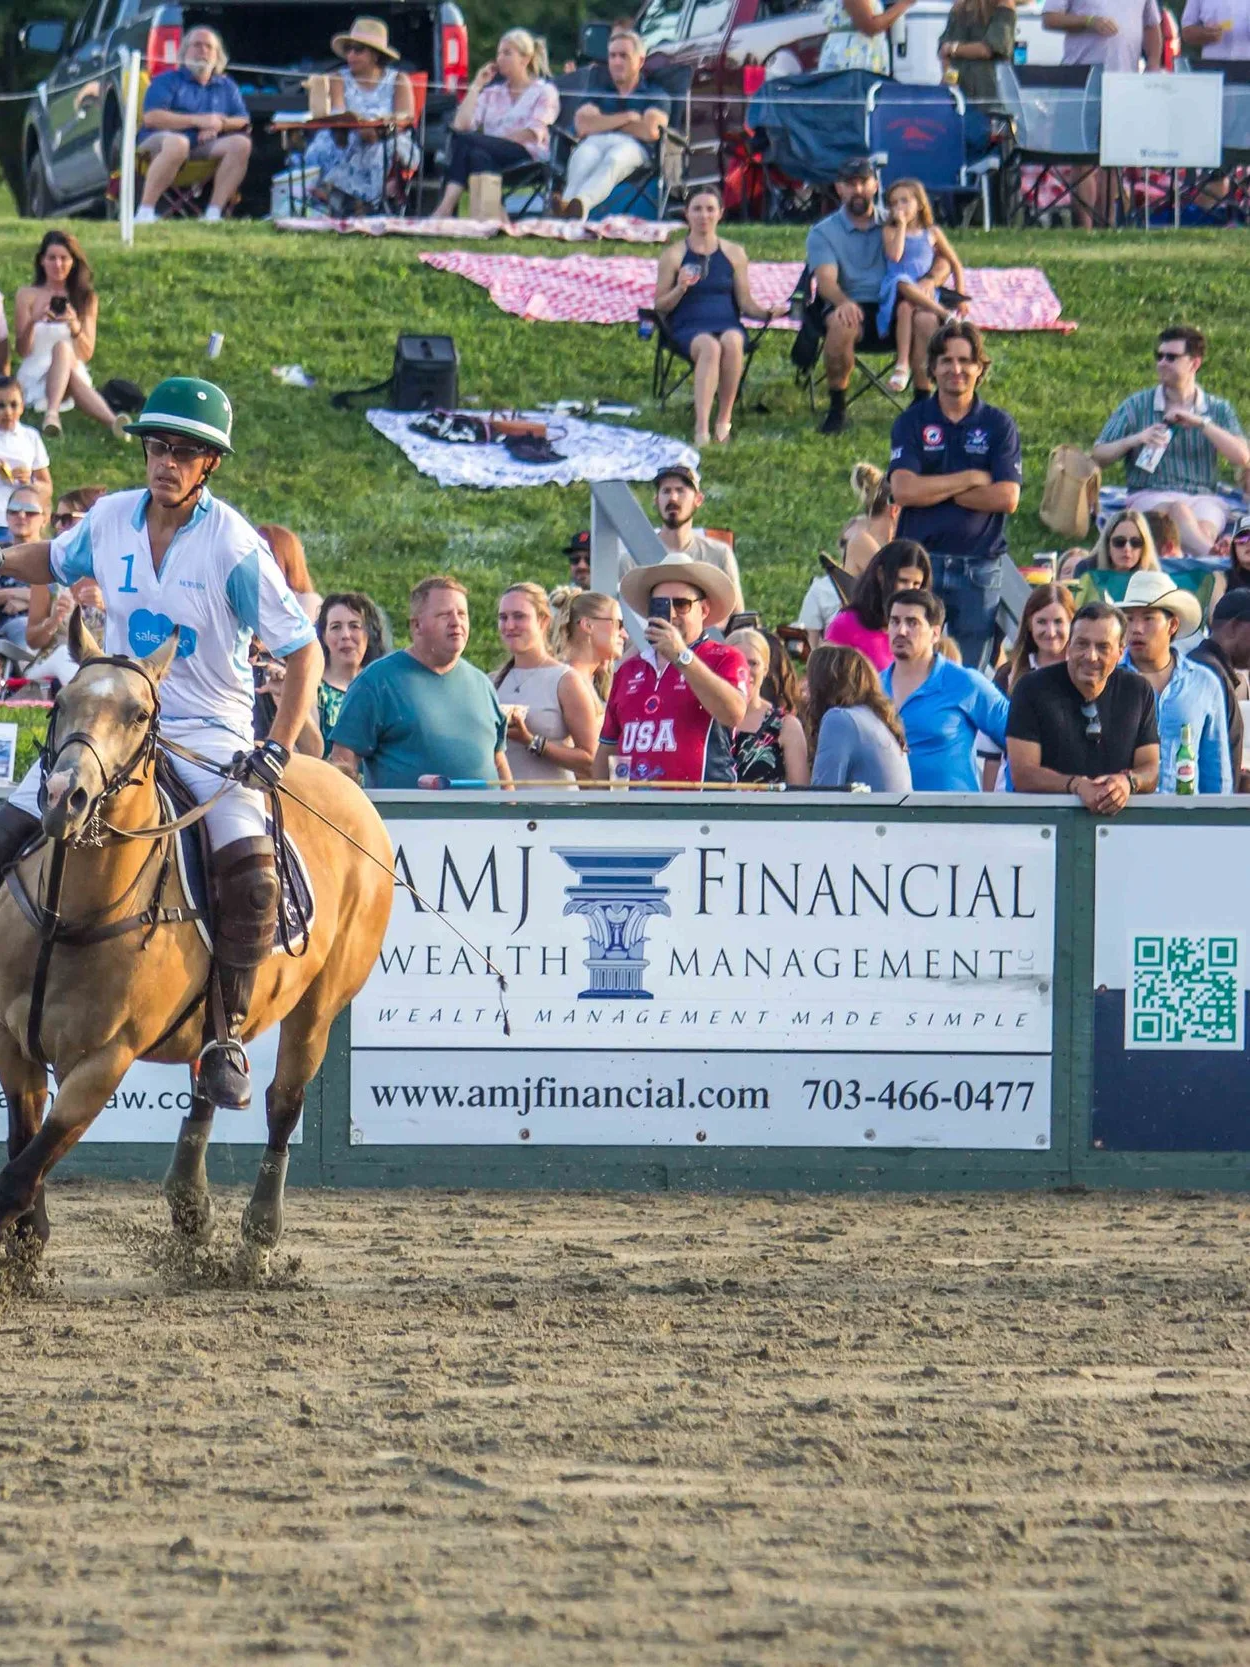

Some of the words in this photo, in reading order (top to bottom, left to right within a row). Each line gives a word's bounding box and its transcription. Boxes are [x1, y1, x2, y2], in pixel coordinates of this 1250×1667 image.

[118, 554, 138, 593] 1
[135, 629, 191, 648] salese
[622, 718, 677, 754] USA
[394, 843, 535, 935] AMJ
[695, 847, 1036, 918] FINANCIAL
[378, 945, 568, 976] WEALTH
[669, 947, 1013, 980] MANAGEMENT
[377, 1008, 510, 1024] WEALTH
[535, 1009, 769, 1025] MANAGEMENT
[791, 1010, 884, 1027] MADE
[905, 1012, 1030, 1028] SIMPLE
[371, 1076, 770, 1116] www.amjfinancial.com
[802, 1079, 1036, 1112] 703-466-0477
